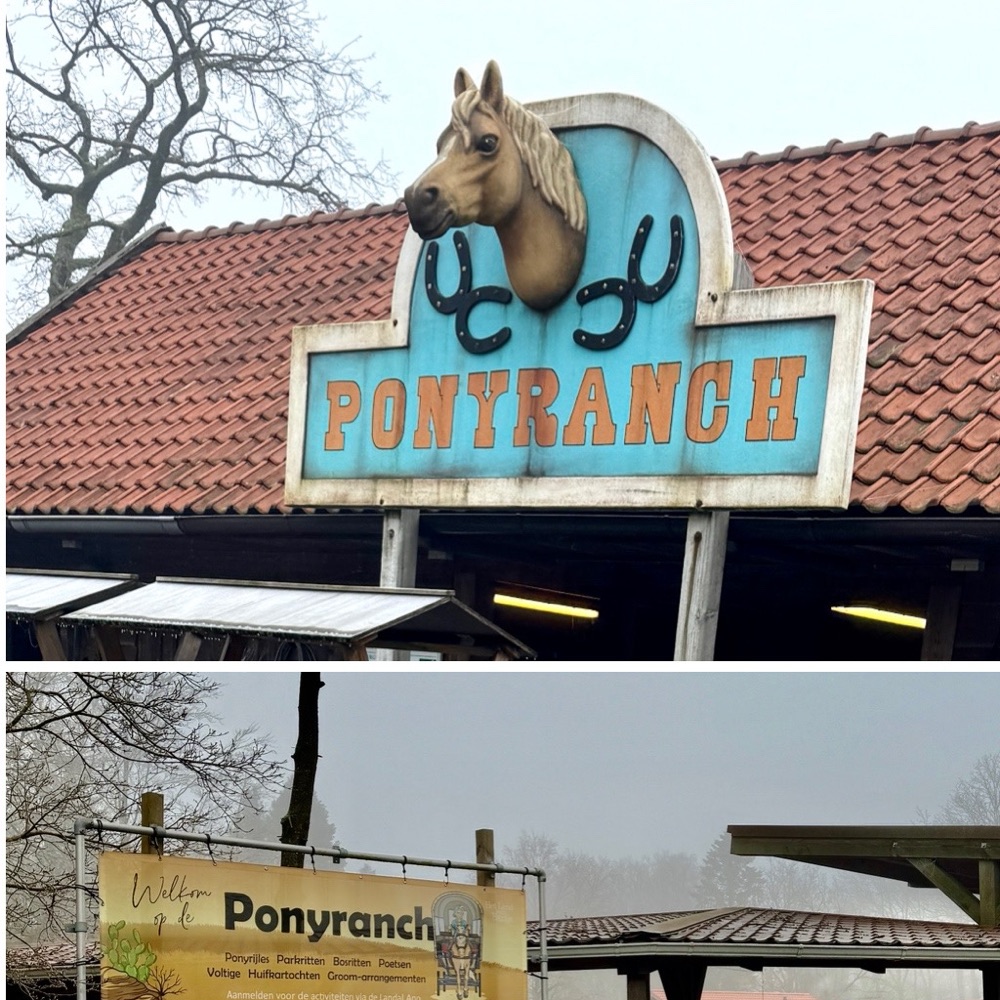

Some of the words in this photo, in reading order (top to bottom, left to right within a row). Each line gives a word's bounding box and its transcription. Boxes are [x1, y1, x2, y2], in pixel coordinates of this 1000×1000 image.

[324, 355, 807, 451] PONYRANCH
[132, 872, 212, 908] Welkom
[153, 912, 167, 936] op
[177, 901, 194, 930] de
[224, 892, 434, 942] Ponyranch
[207, 967, 241, 979] Voltige
[248, 968, 320, 980] Huifkartochten
[327, 971, 426, 984] Groom-arrangementen
[225, 952, 270, 965] Ponyrijles
[276, 954, 325, 966] Parkritten
[333, 956, 371, 968] Bosritten
[378, 958, 411, 969] Poetsen
[226, 990, 274, 1000] Aanmelden
[275, 992, 295, 1000] voor
[297, 991, 309, 1000] de
[310, 992, 354, 1000] activiteiten
[355, 993, 367, 1000] via
[368, 993, 378, 1000] de
